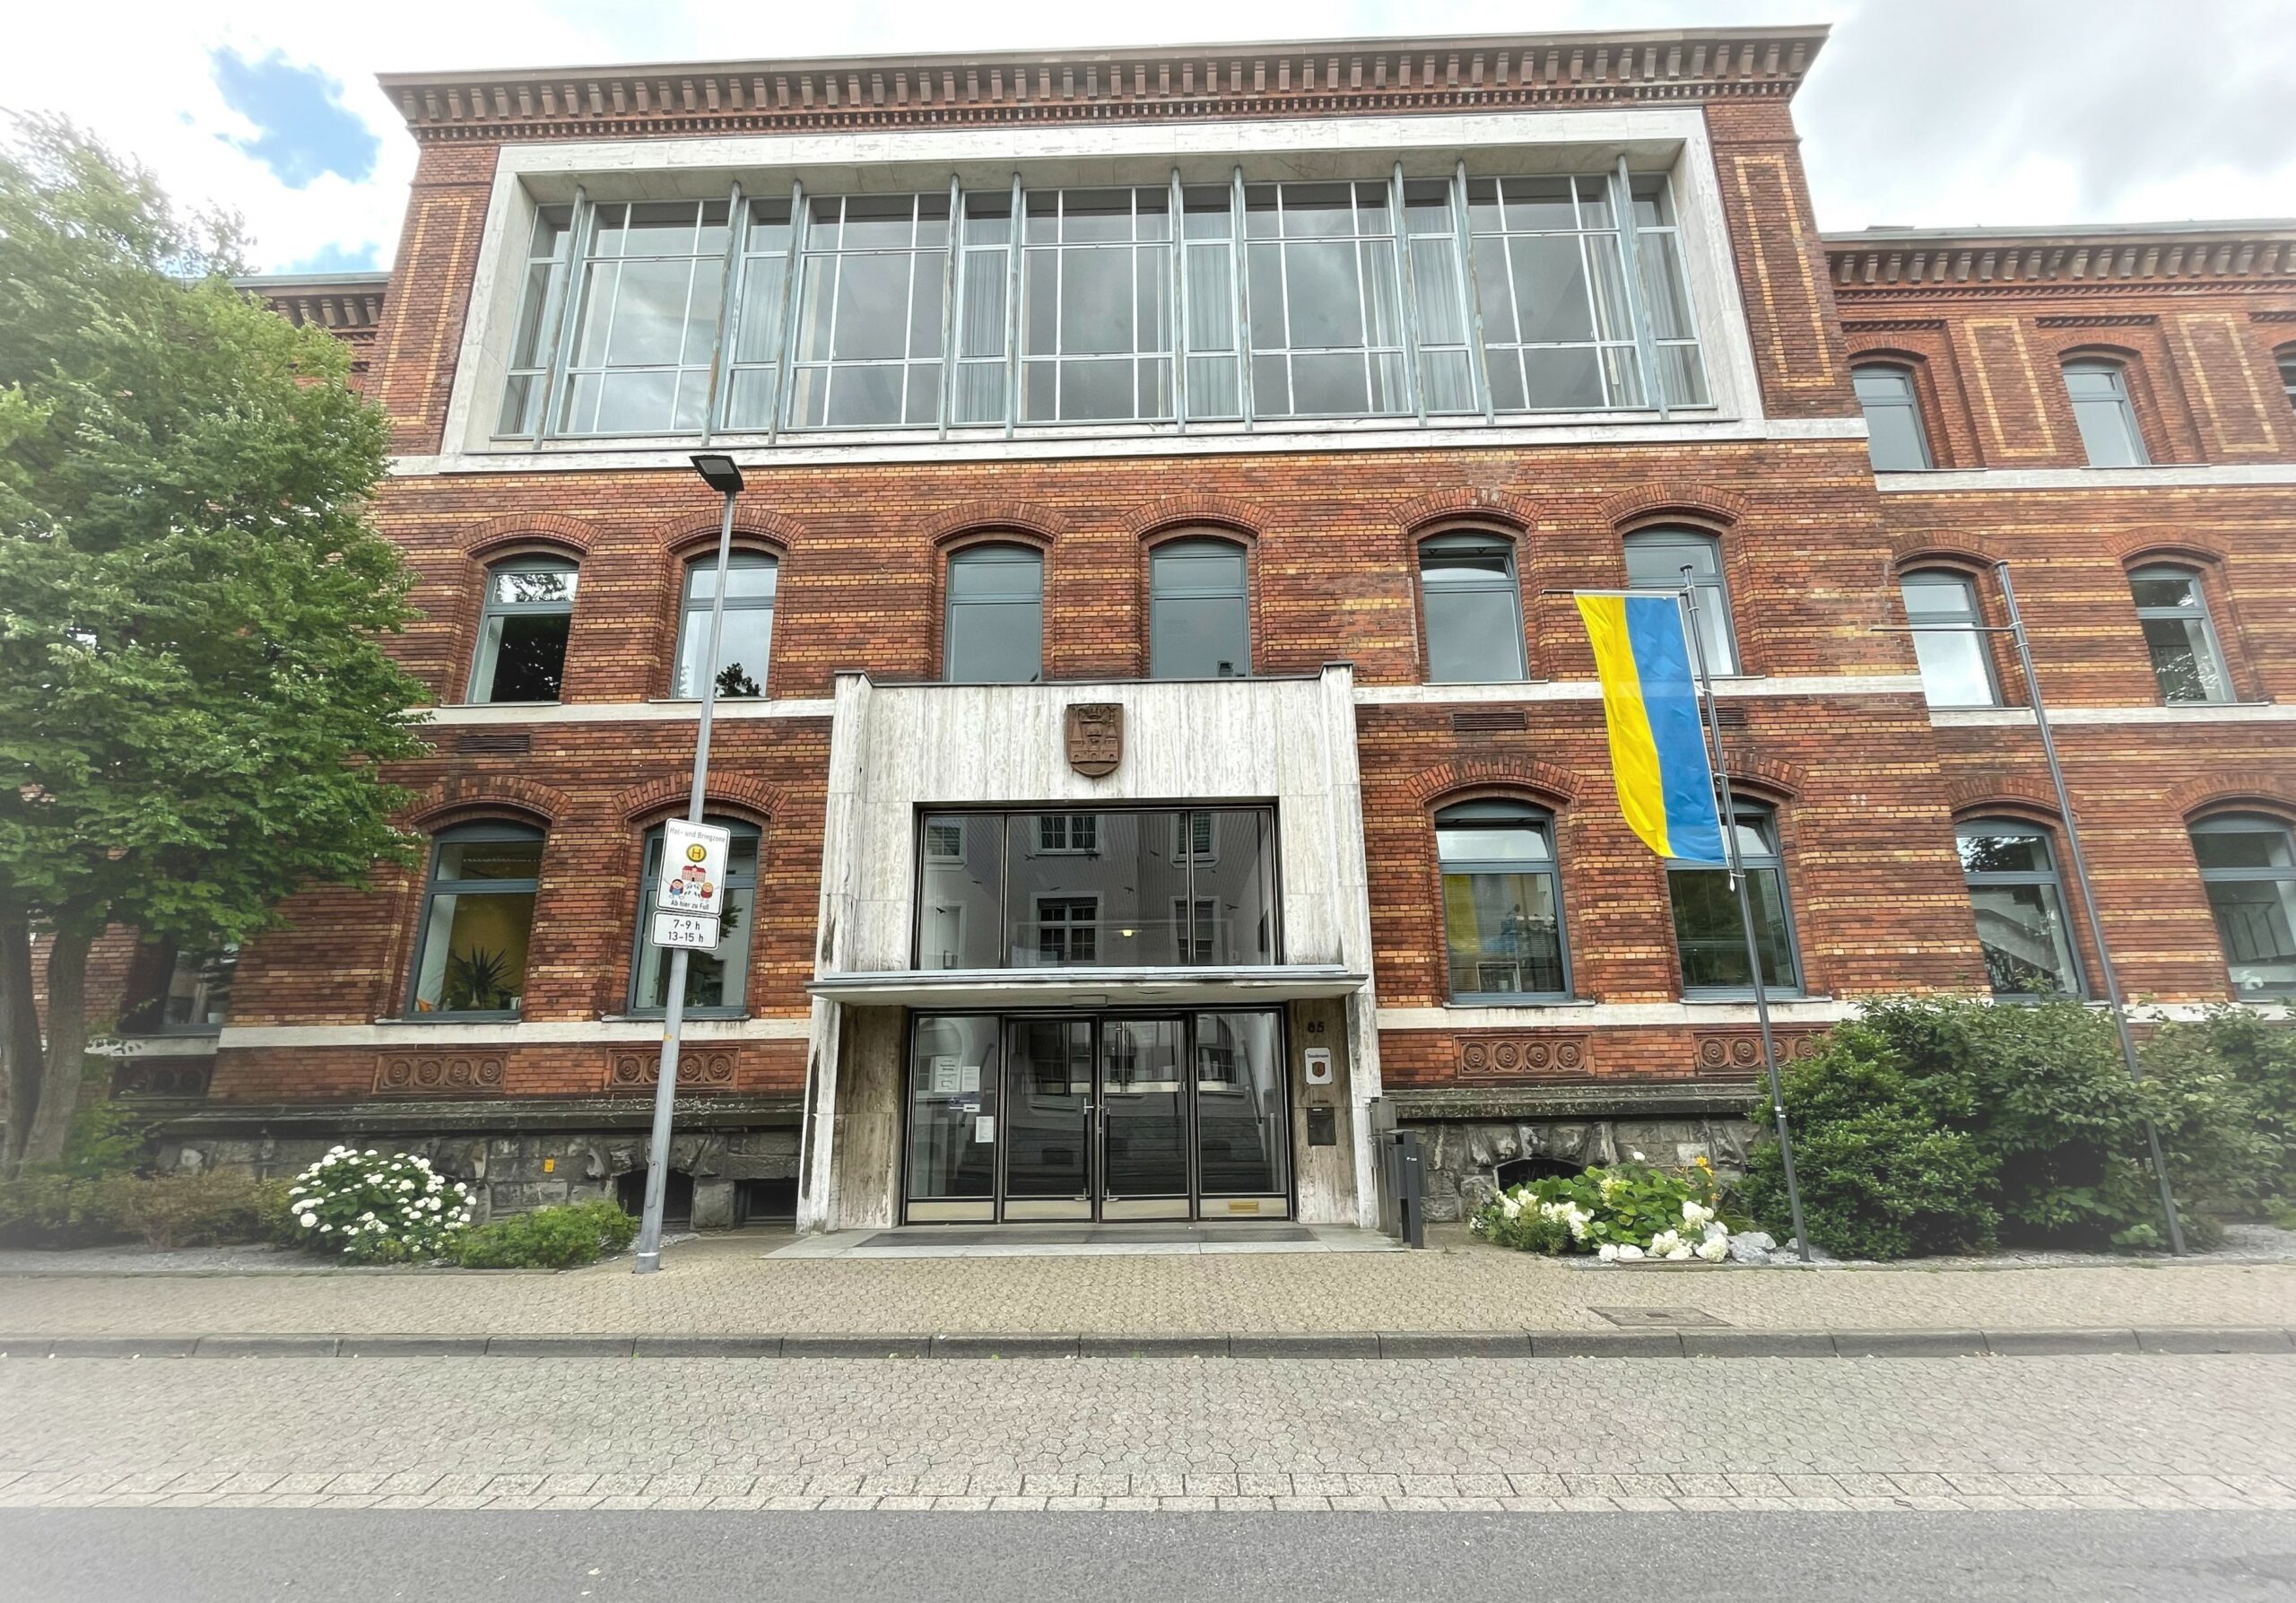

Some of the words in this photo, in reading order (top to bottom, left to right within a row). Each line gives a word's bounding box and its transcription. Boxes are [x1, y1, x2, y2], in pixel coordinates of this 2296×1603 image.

[692, 847, 701, 858] H
[674, 919, 691, 929] 7-9
[695, 921, 700, 930] h
[668, 931, 694, 942] 13-15
[699, 934, 704, 943] h
